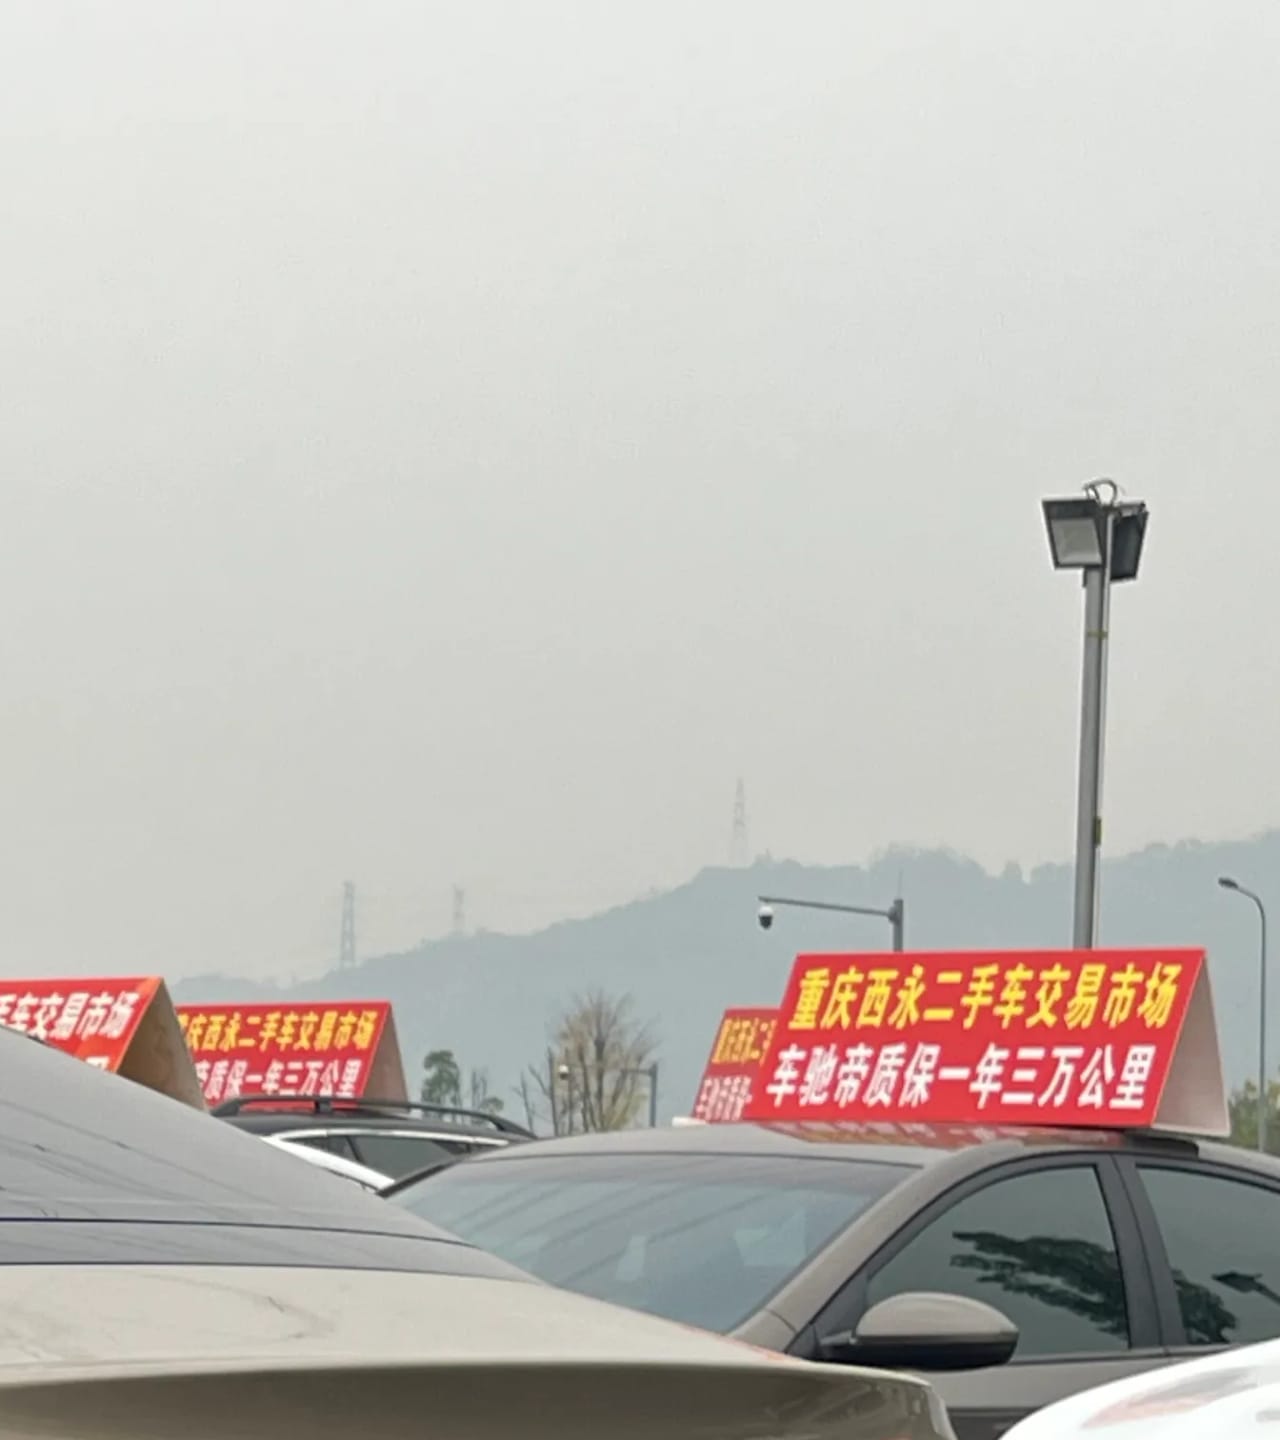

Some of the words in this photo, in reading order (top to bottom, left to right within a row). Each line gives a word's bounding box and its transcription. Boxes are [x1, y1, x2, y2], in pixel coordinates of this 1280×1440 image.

[788, 962, 1183, 1030] 重庆西永二手车交易市场
[178, 1010, 378, 1053] 庆西永二手车交易市场
